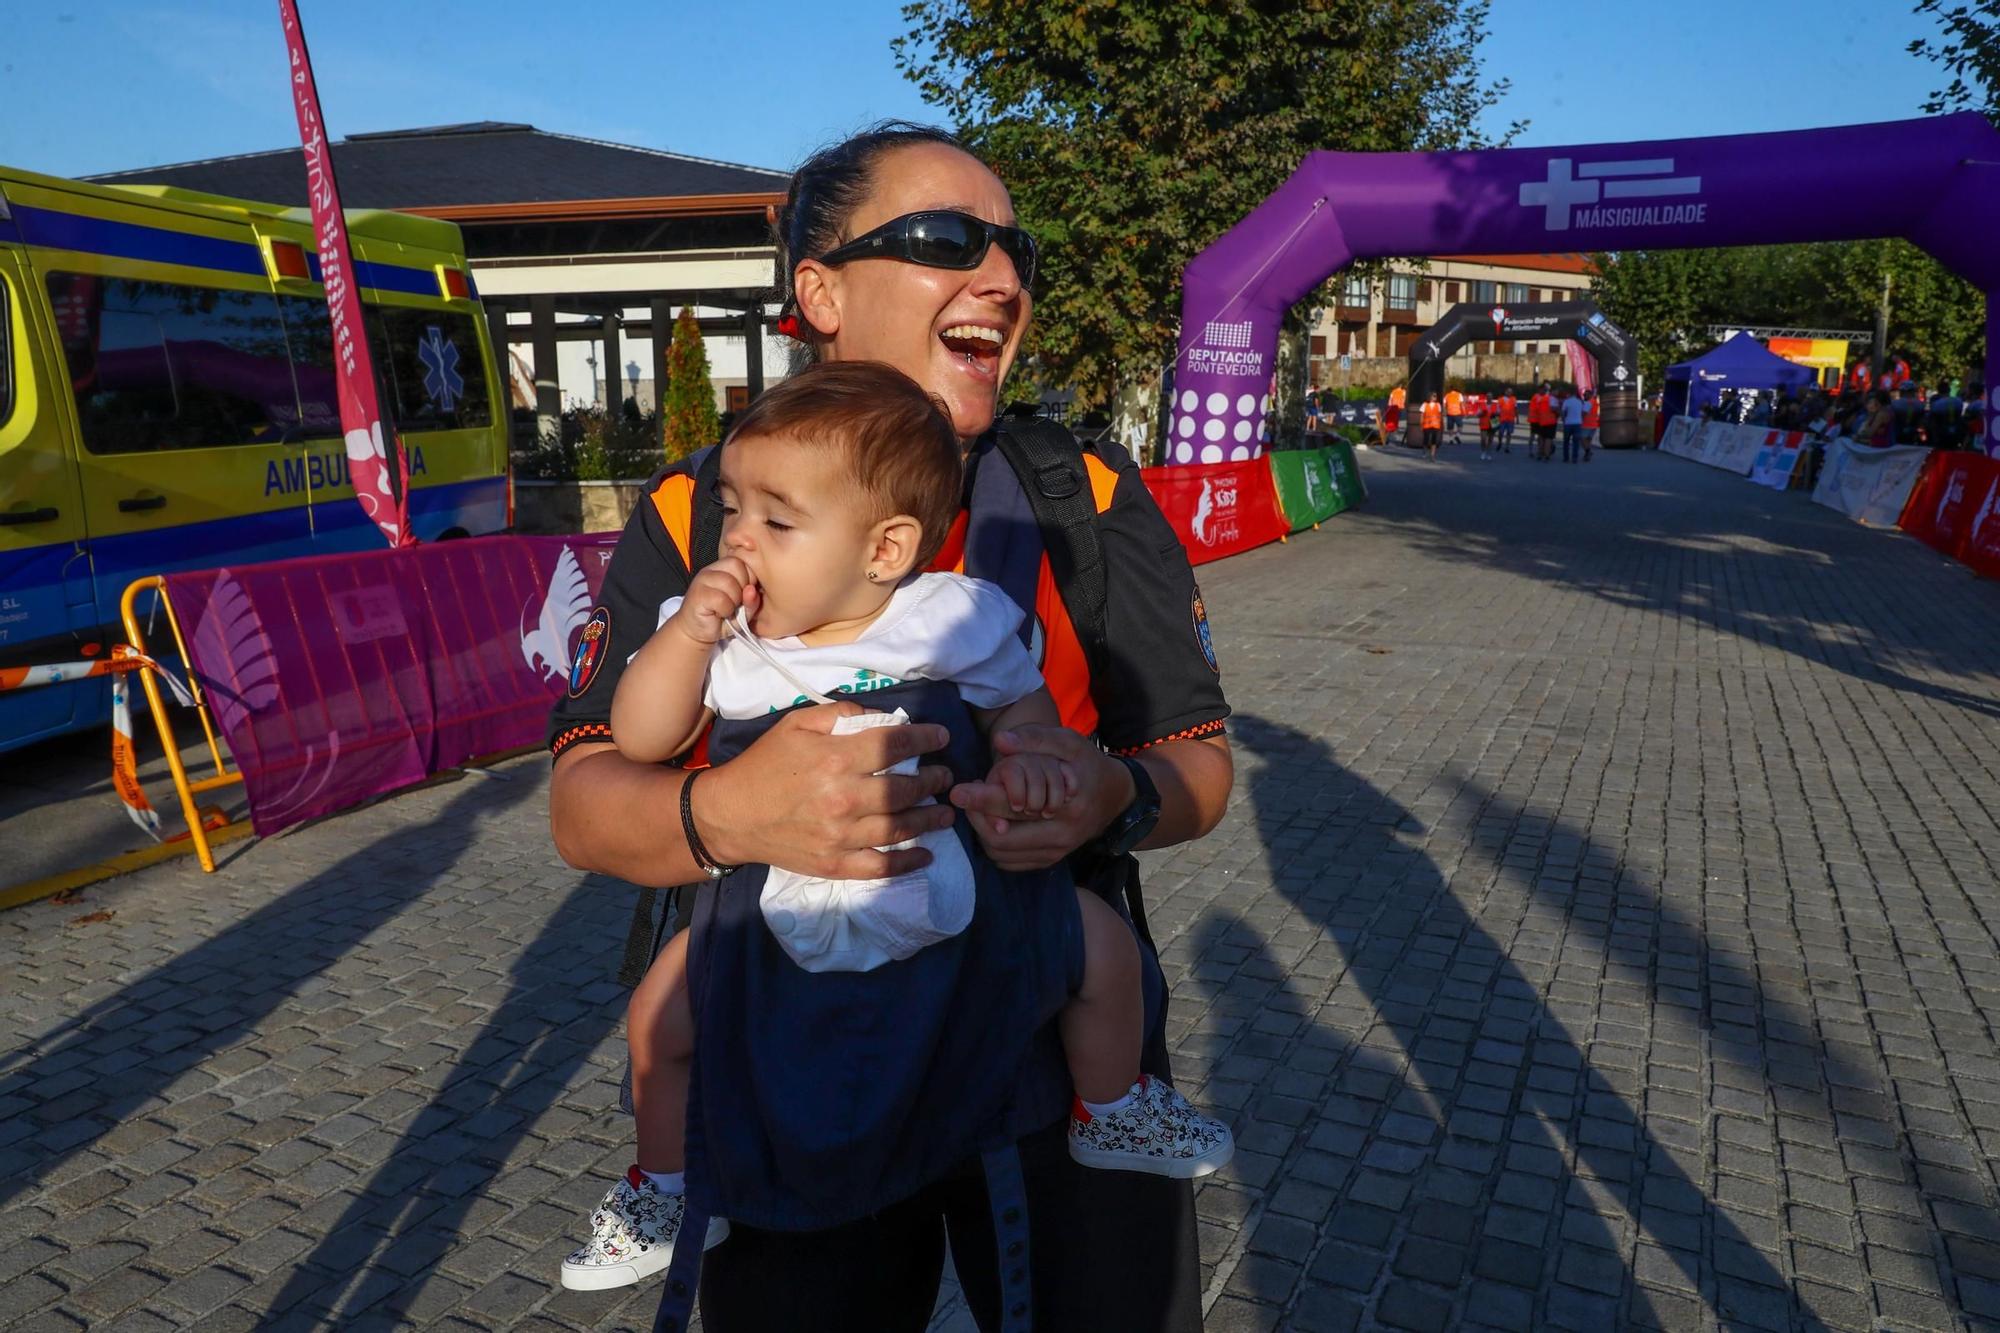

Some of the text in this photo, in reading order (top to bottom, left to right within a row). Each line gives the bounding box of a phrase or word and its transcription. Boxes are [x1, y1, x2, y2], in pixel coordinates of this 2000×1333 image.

[1575, 203, 1707, 229] MÁISIGUALDADE
[1188, 348, 1263, 364] DEPUTACIÓN
[1187, 361, 1262, 377] PONTEVEDRA
